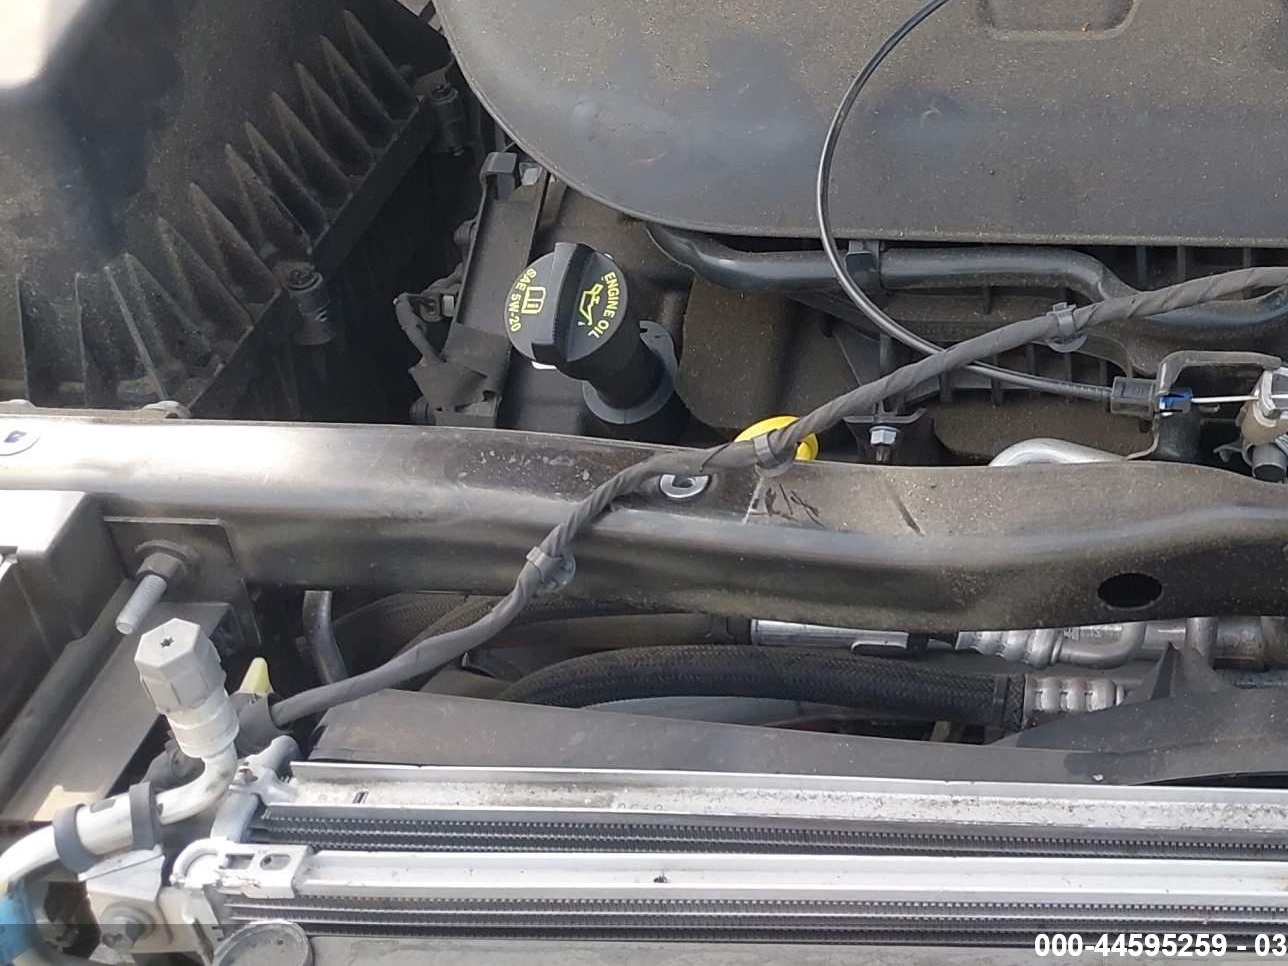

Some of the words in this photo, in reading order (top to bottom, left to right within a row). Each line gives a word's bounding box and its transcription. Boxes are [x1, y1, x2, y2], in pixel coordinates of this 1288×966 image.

[515, 268, 537, 291] SAE
[604, 271, 620, 319] ENGINE
[508, 293, 521, 332] 5W-20
[587, 319, 609, 339] OIL
